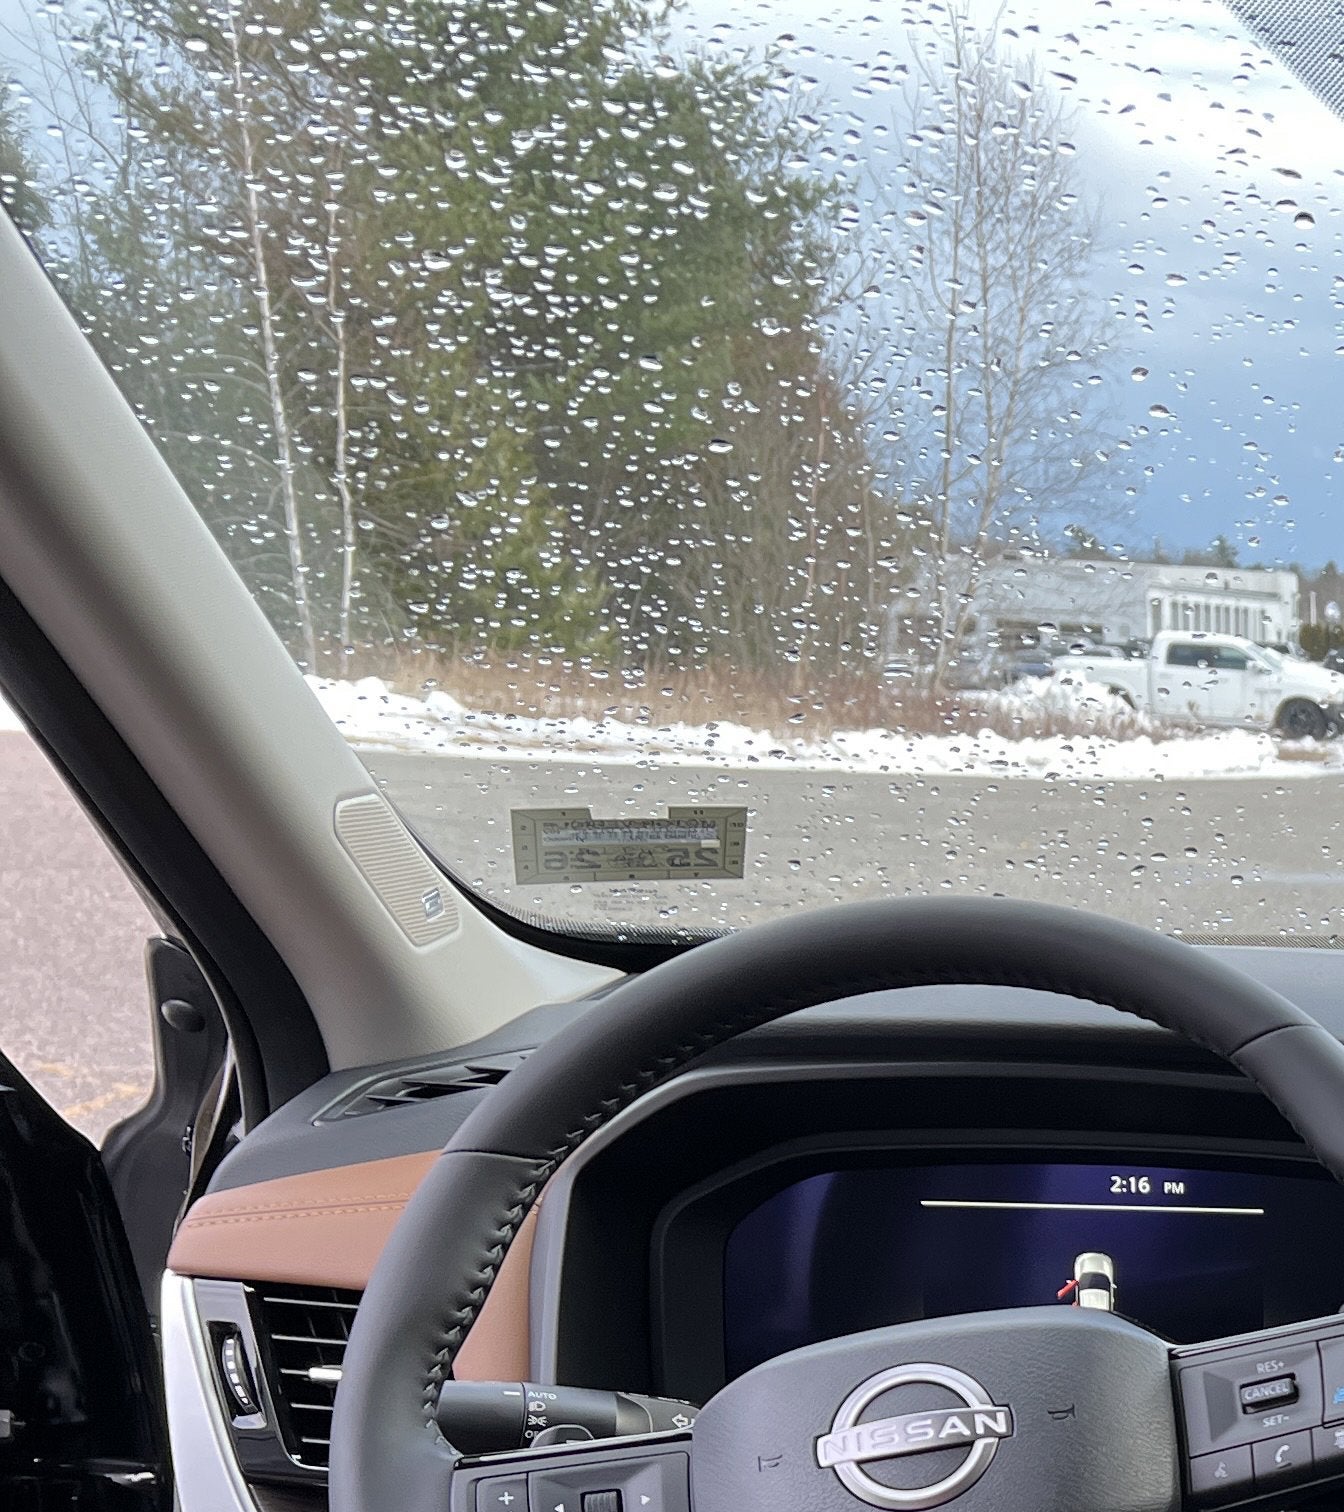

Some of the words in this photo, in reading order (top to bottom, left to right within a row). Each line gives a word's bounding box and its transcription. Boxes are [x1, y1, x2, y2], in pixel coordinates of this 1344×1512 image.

[1110, 1175, 1150, 1194] 2:16
[1163, 1181, 1185, 1194] PM
[1243, 1382, 1290, 1400] CANCEL
[822, 1410, 1007, 1462] NISSAN
